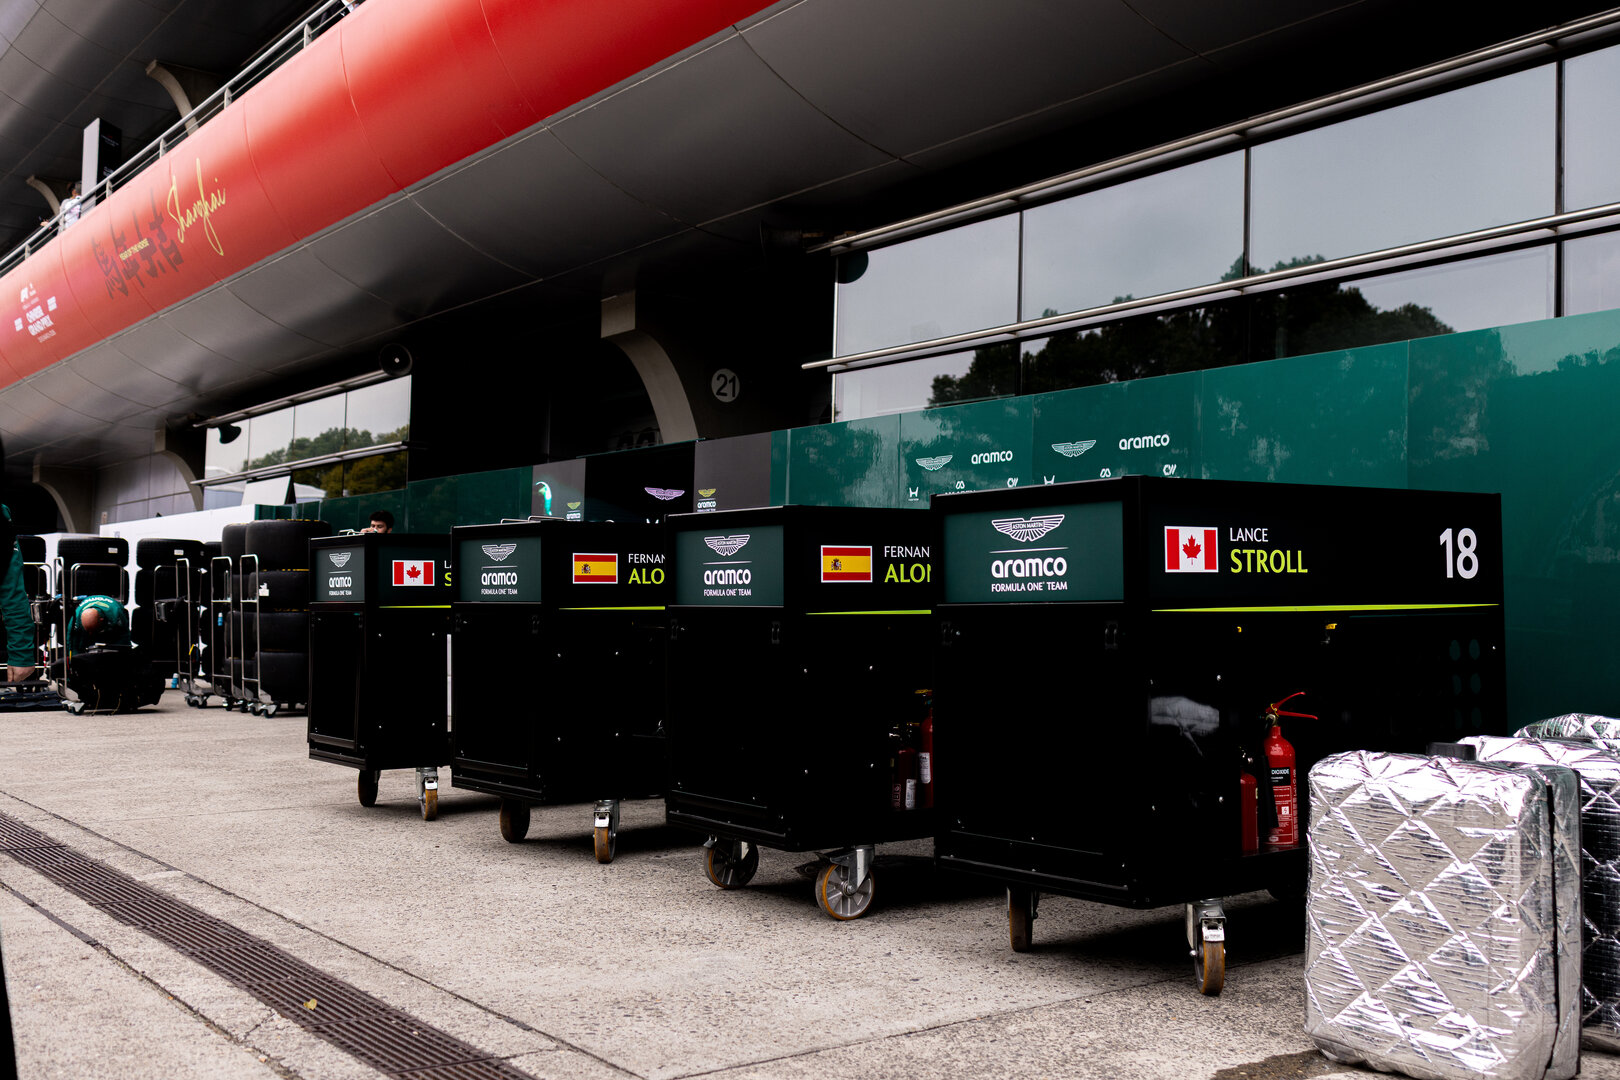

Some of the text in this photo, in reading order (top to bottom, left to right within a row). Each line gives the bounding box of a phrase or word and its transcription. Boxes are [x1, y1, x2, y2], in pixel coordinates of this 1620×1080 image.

[167, 157, 226, 257] Shanghai
[716, 373, 736, 398] 21
[1118, 433, 1170, 451] aramco
[970, 450, 1014, 465] aramco
[1229, 527, 1269, 543] LANCE
[884, 545, 930, 558] FERNAN
[1439, 527, 1479, 580] 18
[991, 556, 1068, 579] aramco
[1230, 548, 1309, 575] STROLL
[329, 576, 352, 588] aramco
[480, 571, 518, 587] aramco
[703, 568, 752, 586] aramco
[703, 589, 726, 597] FORMULA
[738, 588, 752, 596] TEAM
[991, 583, 1026, 593] FORMULA
[1046, 581, 1068, 591] TEAM
